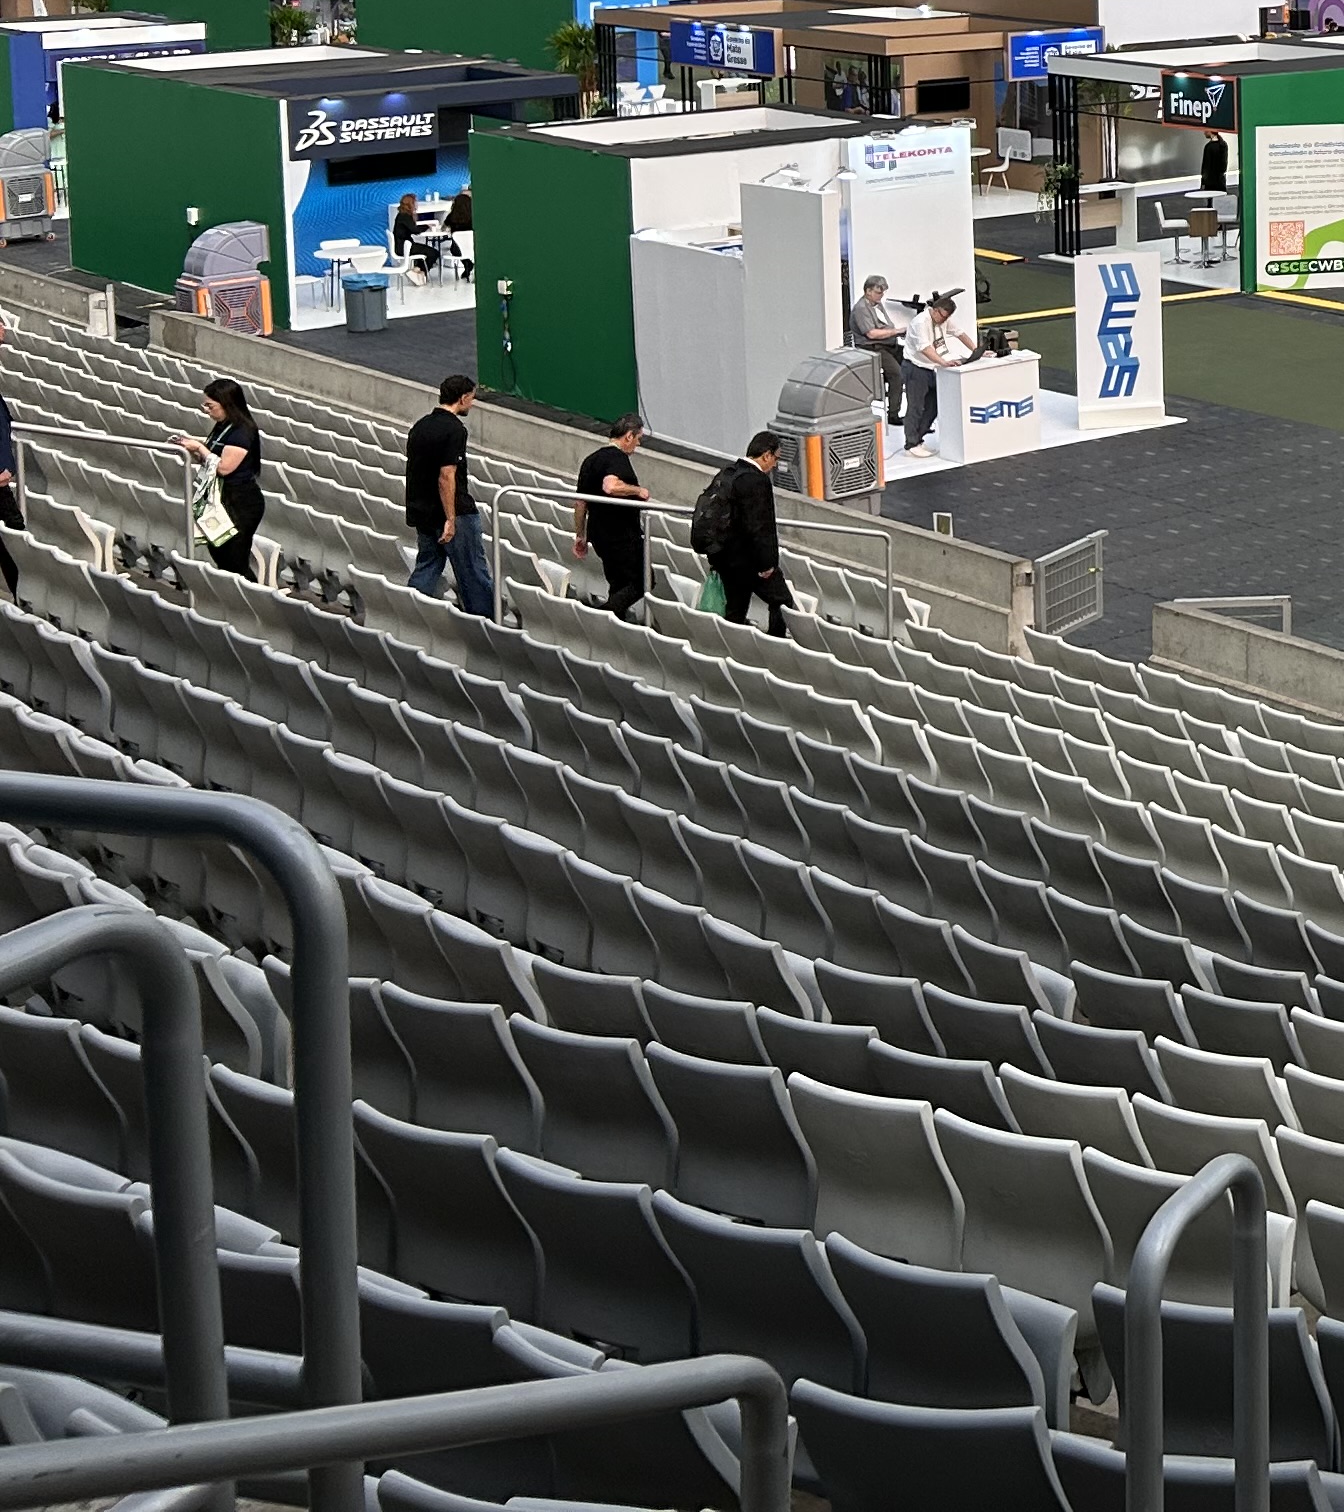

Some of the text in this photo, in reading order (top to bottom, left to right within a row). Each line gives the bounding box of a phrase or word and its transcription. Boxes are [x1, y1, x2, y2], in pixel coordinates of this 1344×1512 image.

[1170, 91, 1212, 123] Finep
[340, 113, 435, 132] DASSAULT
[339, 124, 433, 143] SYSTEMES
[875, 146, 954, 161] TELEKONTA
